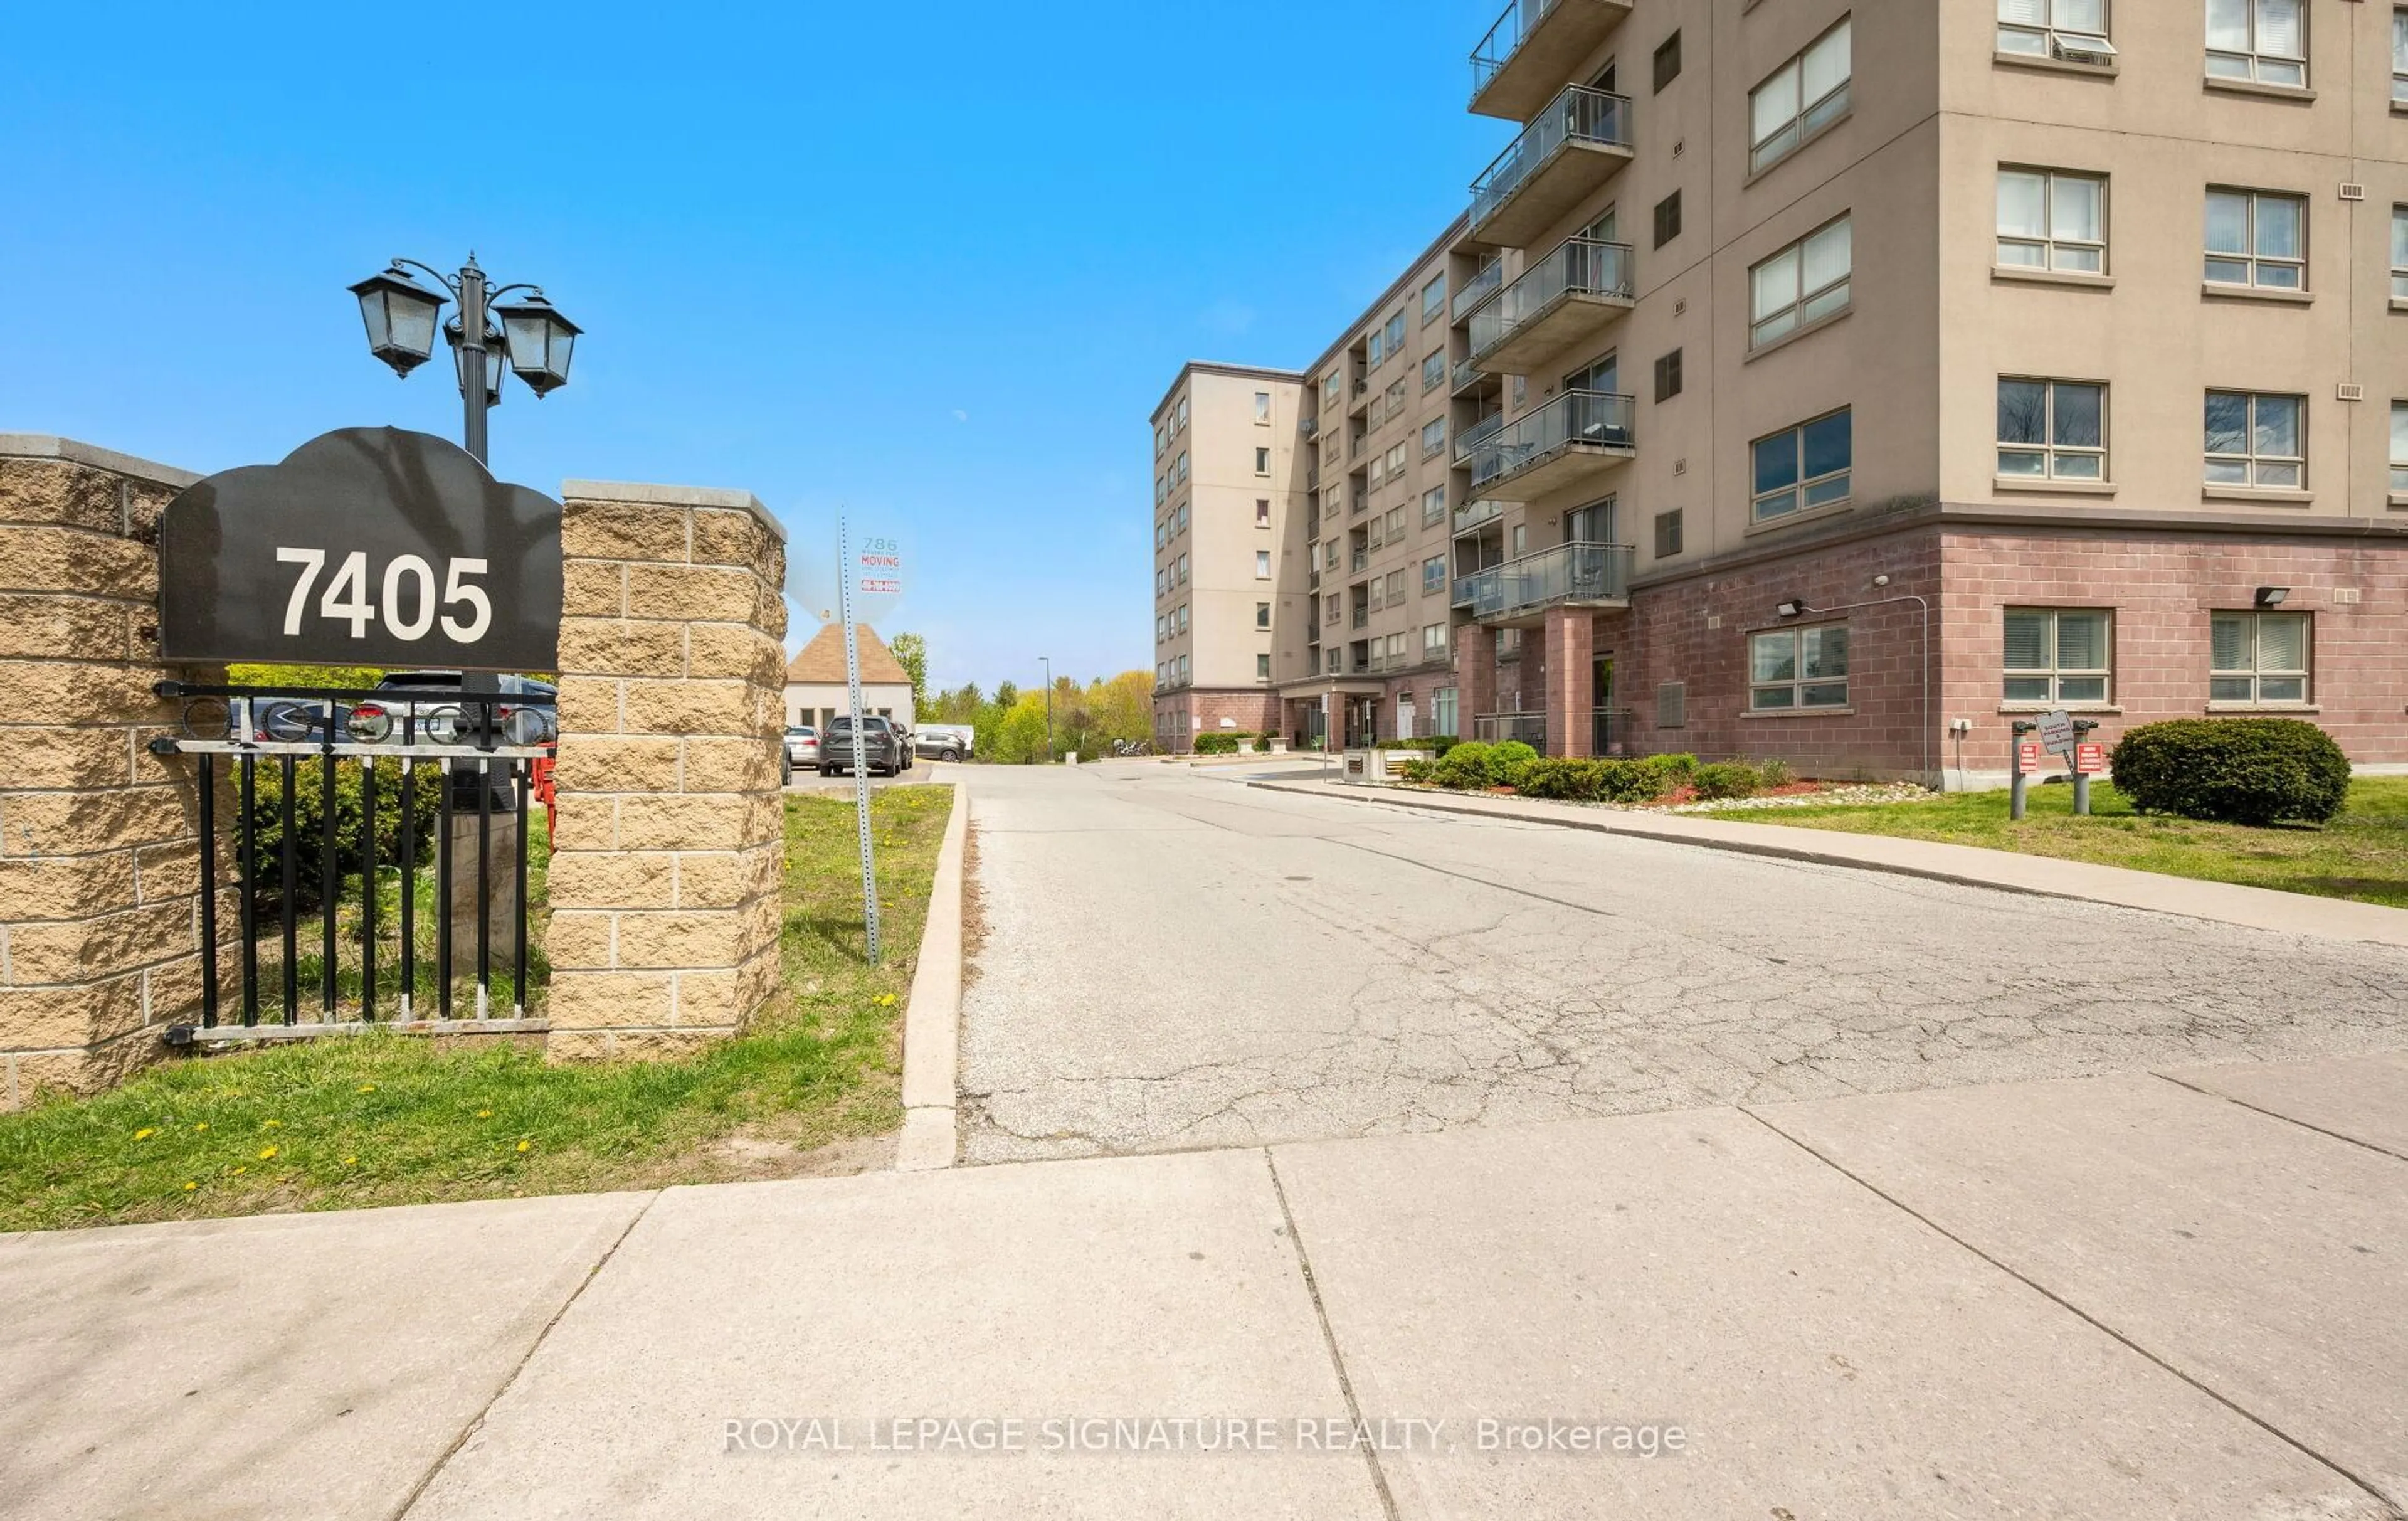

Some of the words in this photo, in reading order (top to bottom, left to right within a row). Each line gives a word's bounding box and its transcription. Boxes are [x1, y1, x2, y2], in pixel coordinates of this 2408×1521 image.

[863, 538, 897, 551] 786
[862, 556, 899, 567] MOVING
[277, 547, 492, 644] 7405
